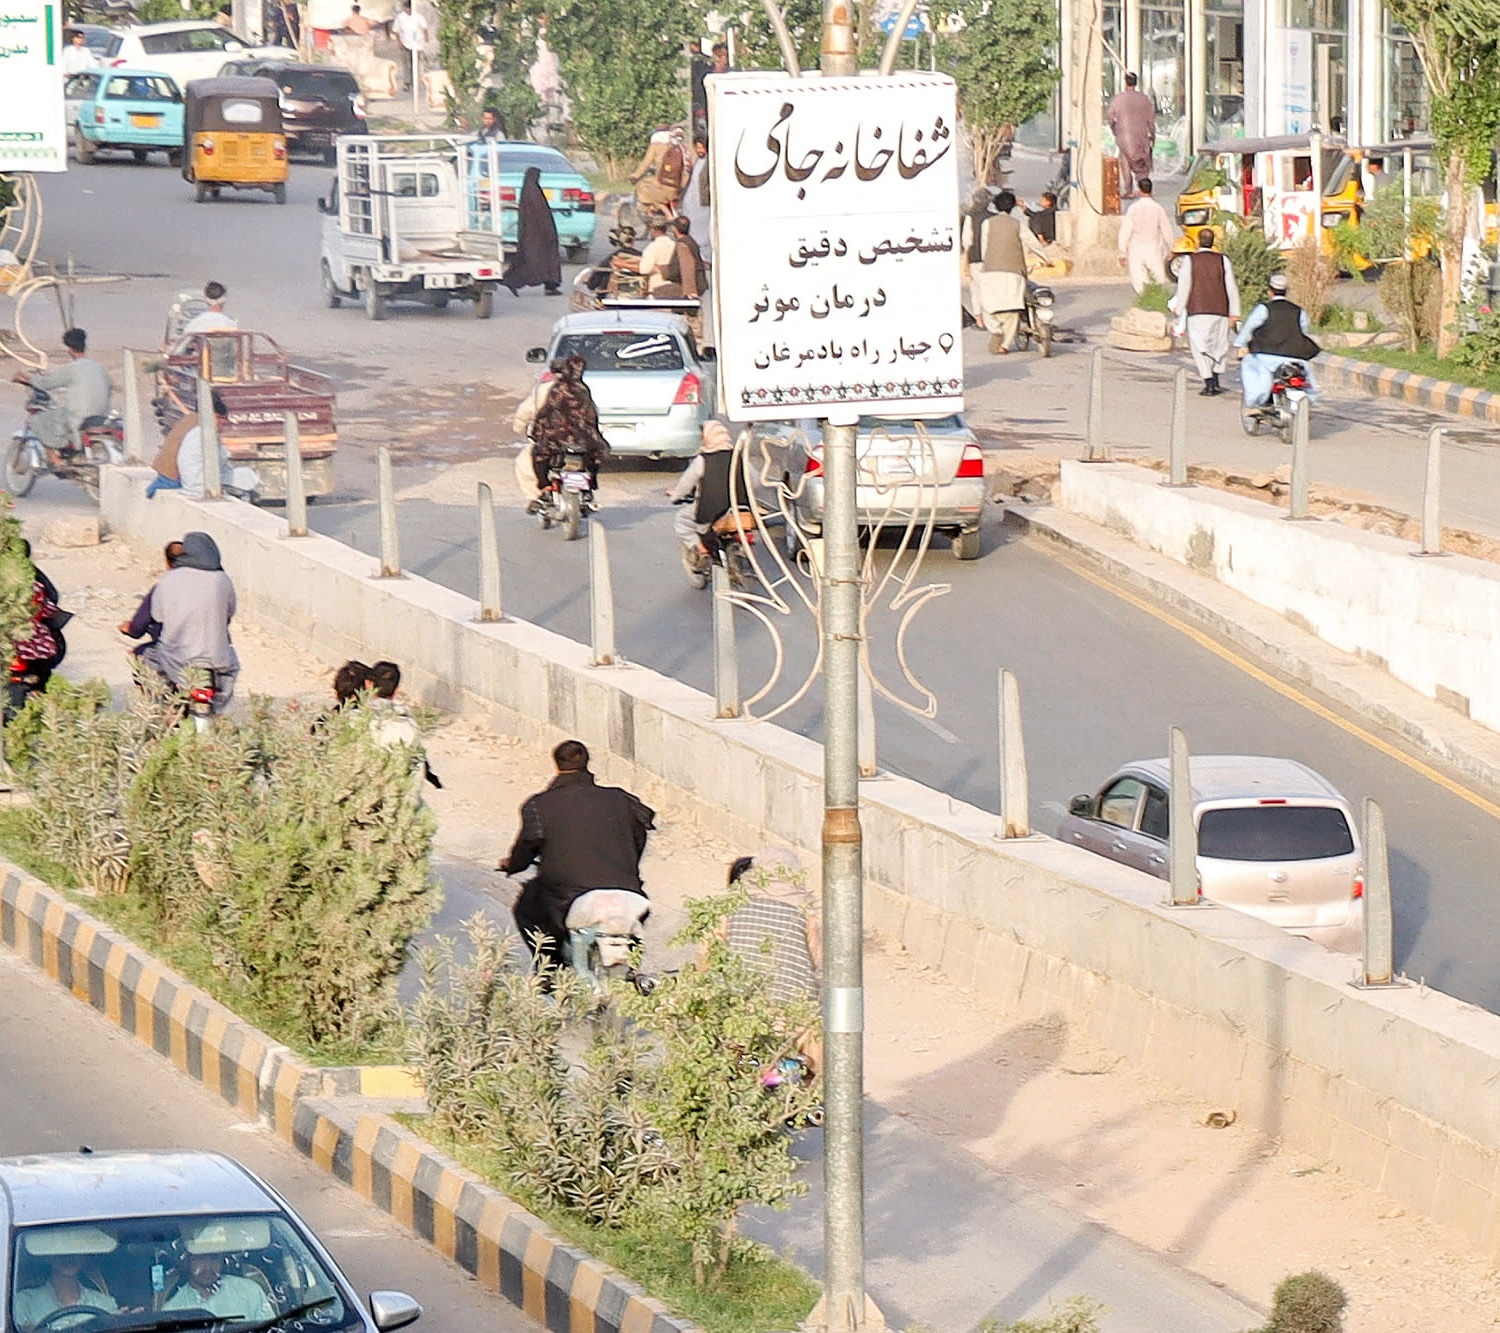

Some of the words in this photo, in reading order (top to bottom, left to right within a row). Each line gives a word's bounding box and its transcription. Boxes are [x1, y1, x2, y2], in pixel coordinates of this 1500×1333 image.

[734, 102, 825, 200] جامی
[820, 115, 952, 184] شفاخانه
[789, 229, 848, 268] دقیق
[858, 227, 954, 265] تشخیص
[748, 283, 800, 323] موثر
[810, 284, 887, 319] درمان
[850, 337, 880, 365] راه
[888, 336, 932, 364] چهار
